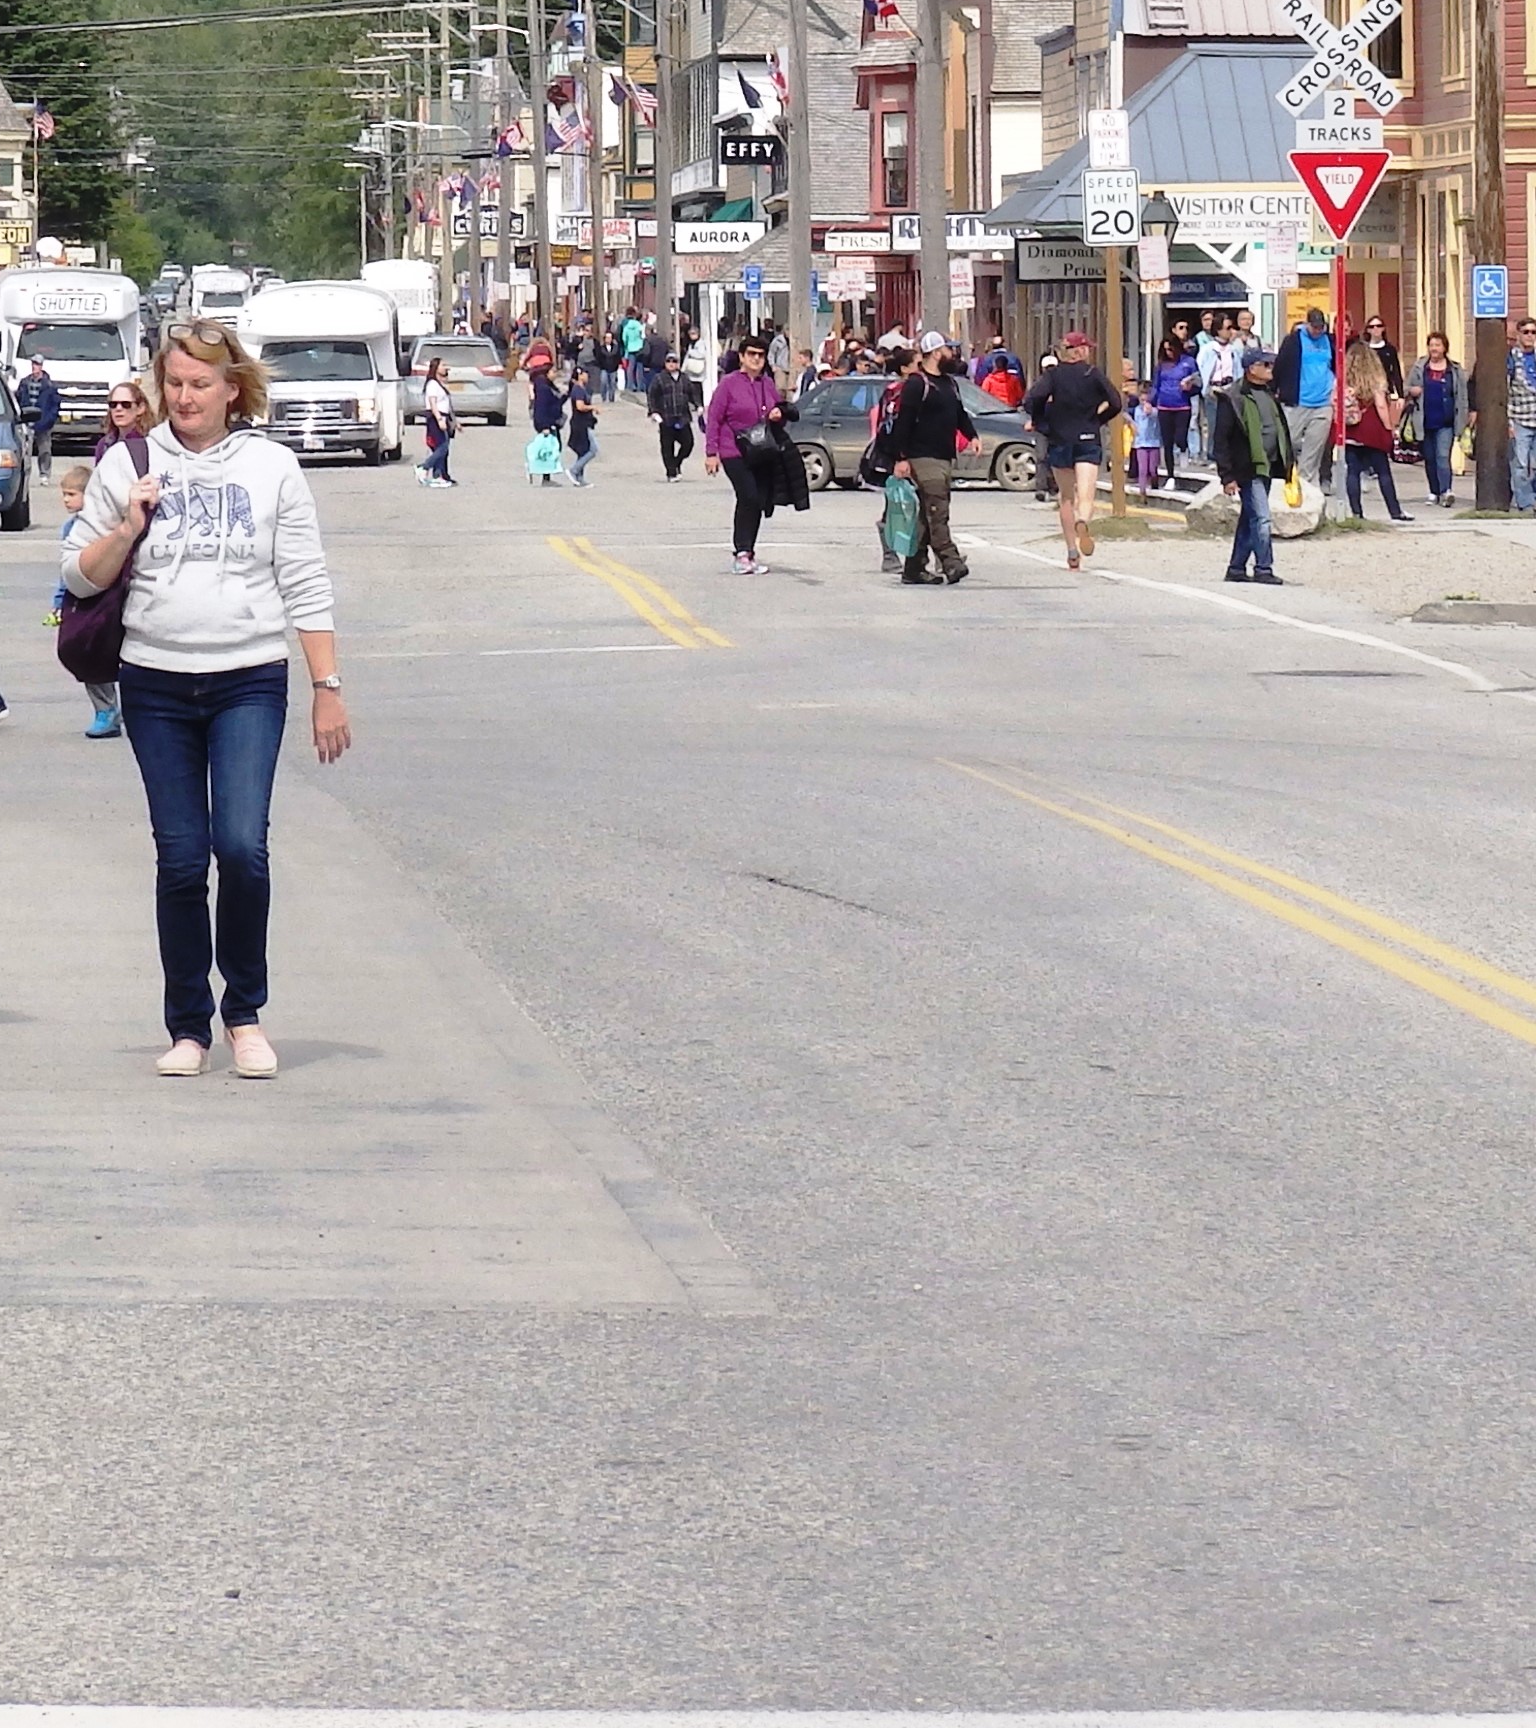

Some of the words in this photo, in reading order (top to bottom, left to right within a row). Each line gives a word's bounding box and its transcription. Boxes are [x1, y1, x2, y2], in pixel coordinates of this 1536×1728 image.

[1333, 98, 1346, 116] 2
[1101, 117, 1116, 126] NO
[1308, 127, 1372, 141] TRACKS
[726, 142, 774, 157] EFFY
[1100, 141, 1117, 150] ANY
[1099, 152, 1121, 161] TIME
[1088, 177, 1134, 189] SPEED
[1324, 173, 1354, 184] YIELD
[1093, 193, 1129, 204] LIMIT
[1250, 194, 1310, 215] CENTE
[1091, 210, 1134, 235] 20
[689, 231, 751, 243] AURORA
[840, 234, 891, 249] FRESH
[39, 297, 101, 311] SHUTTLE
